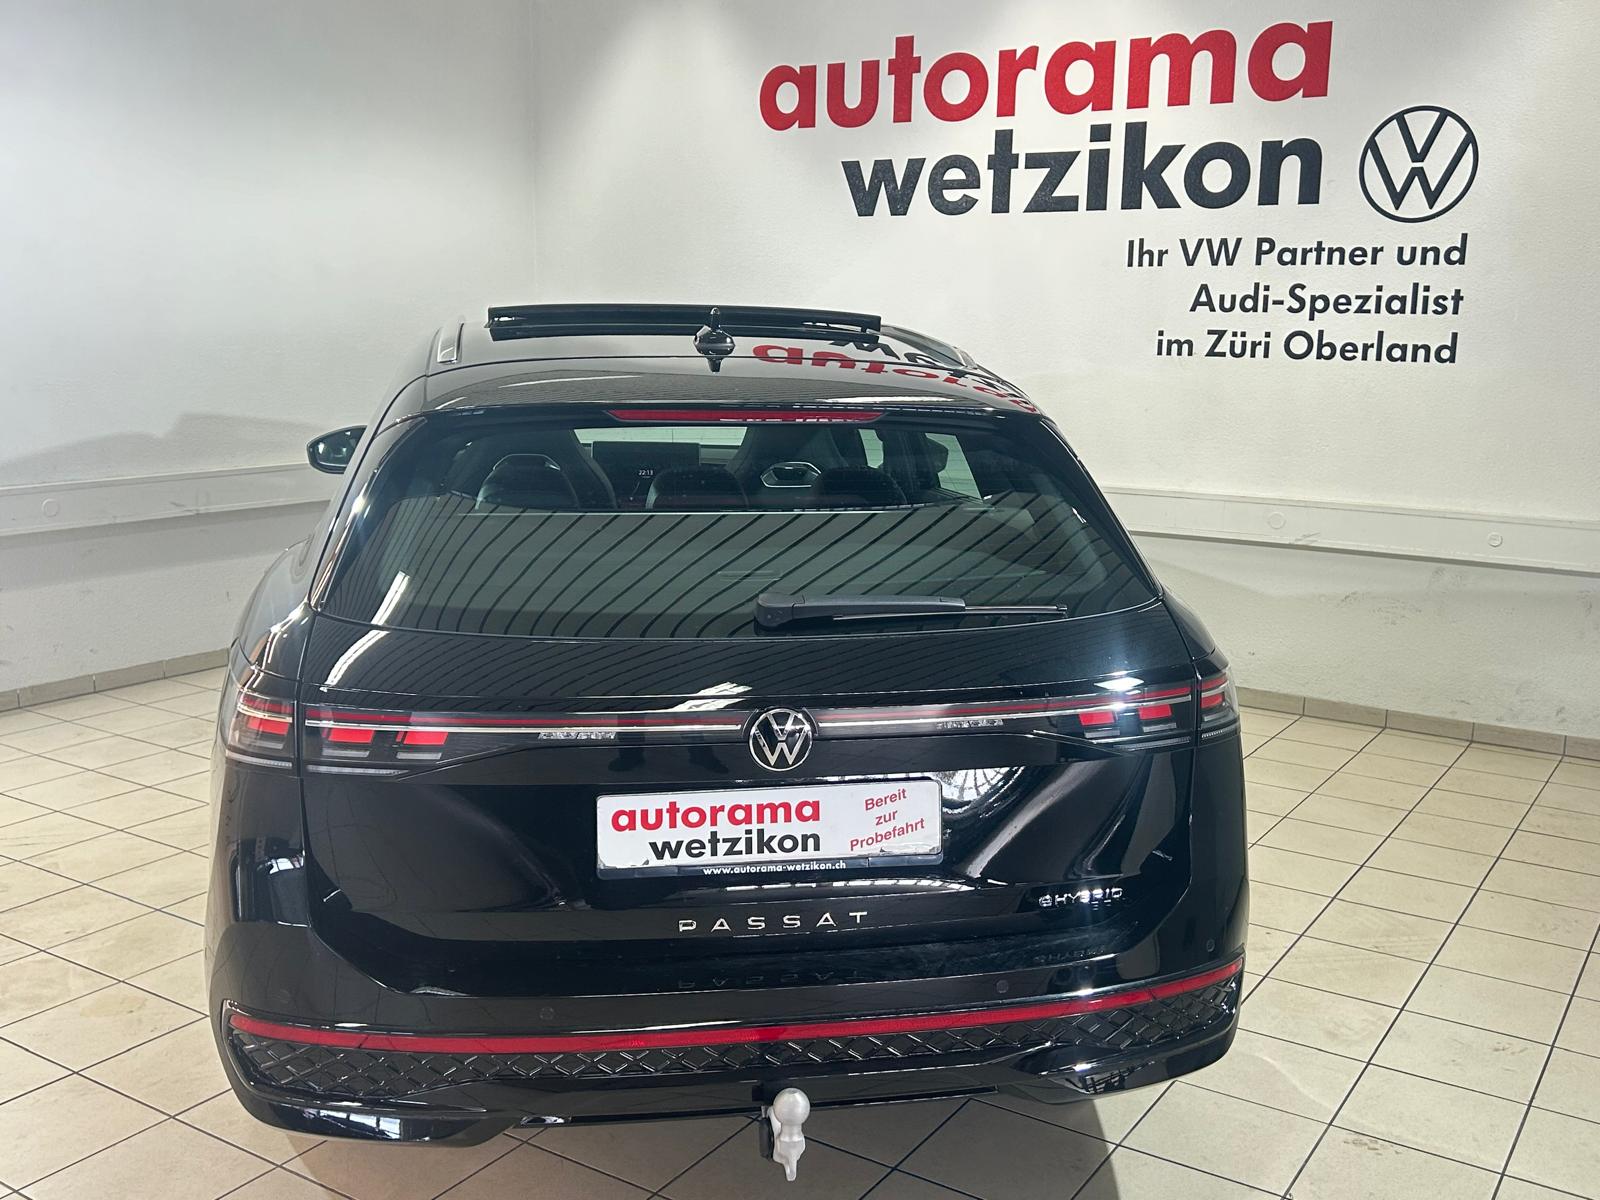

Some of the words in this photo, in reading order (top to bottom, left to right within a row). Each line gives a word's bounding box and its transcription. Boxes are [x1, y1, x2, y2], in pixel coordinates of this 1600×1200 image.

[760, 21, 1333, 131] autorama
[842, 121, 1323, 217] wetzikon
[1127, 238, 1168, 268] Ihr
[1180, 238, 1243, 267] VW
[1255, 237, 1384, 267] Partner
[1396, 233, 1468, 266] und
[1189, 282, 1465, 319] Audi-Spezialist
[1156, 331, 1194, 358] im
[1204, 329, 1271, 360] Züri
[1283, 330, 1459, 364] Oberland
[611, 799, 821, 832] autorama
[864, 788, 907, 811] Bereit
[875, 808, 898, 825] zur
[649, 829, 821, 861] wetzikon
[849, 818, 925, 851] Probefahrt
[703, 860, 847, 876] www.autorama-wetzikon.ch
[678, 911, 868, 933] PASSAT
